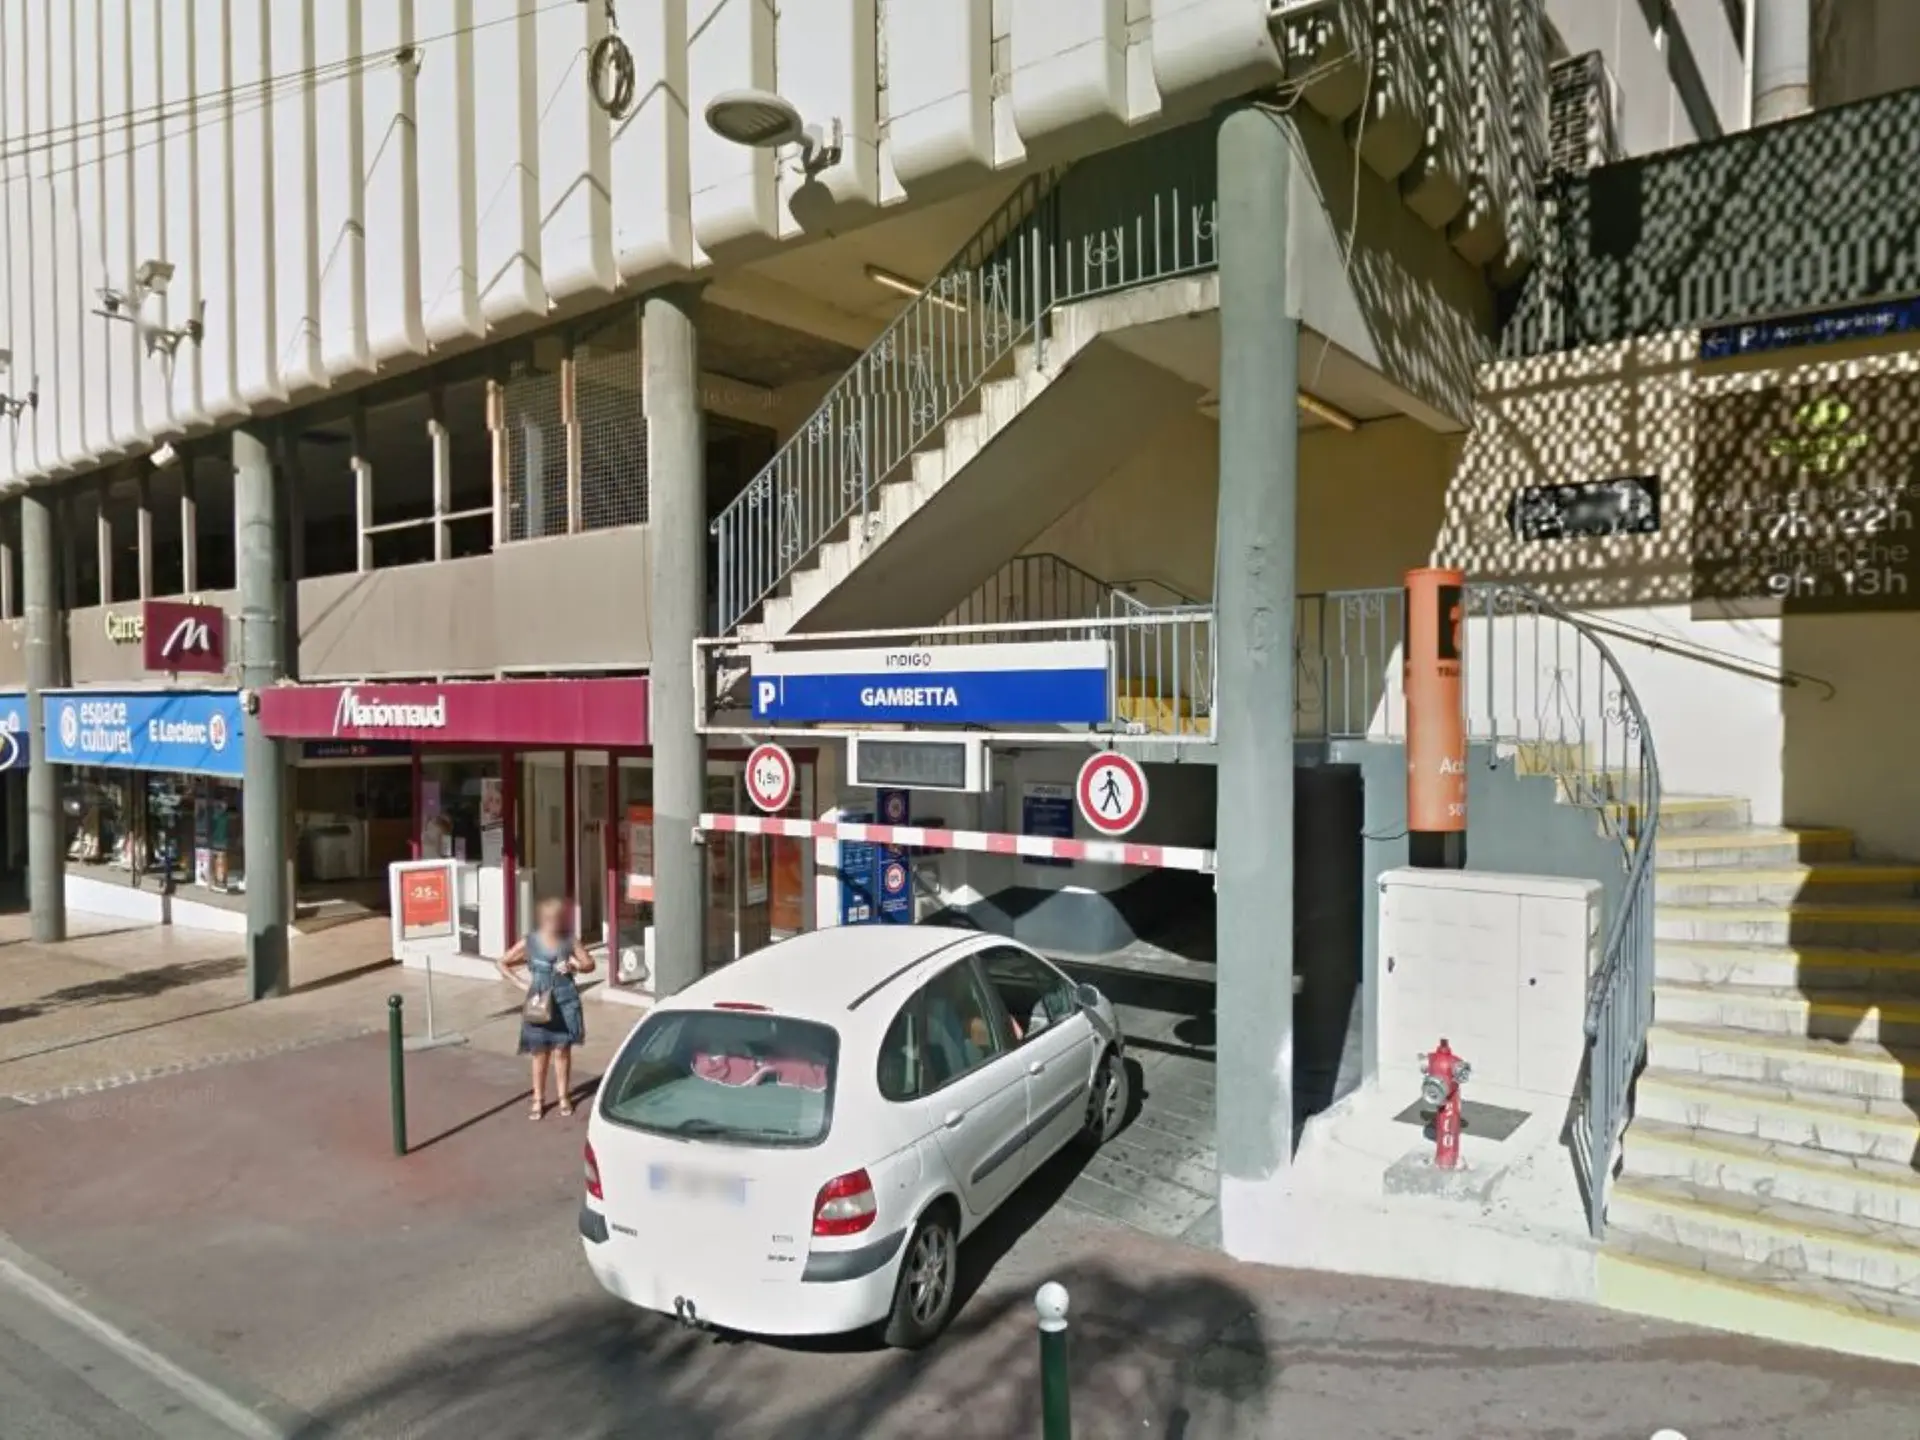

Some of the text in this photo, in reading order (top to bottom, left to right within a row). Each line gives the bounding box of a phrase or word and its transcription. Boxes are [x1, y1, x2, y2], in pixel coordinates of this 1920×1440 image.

[332, 687, 447, 737] Marionnaud
[758, 680, 959, 715] P GAMBETTA
[80, 702, 127, 730] espace
[80, 727, 133, 755] culturel
